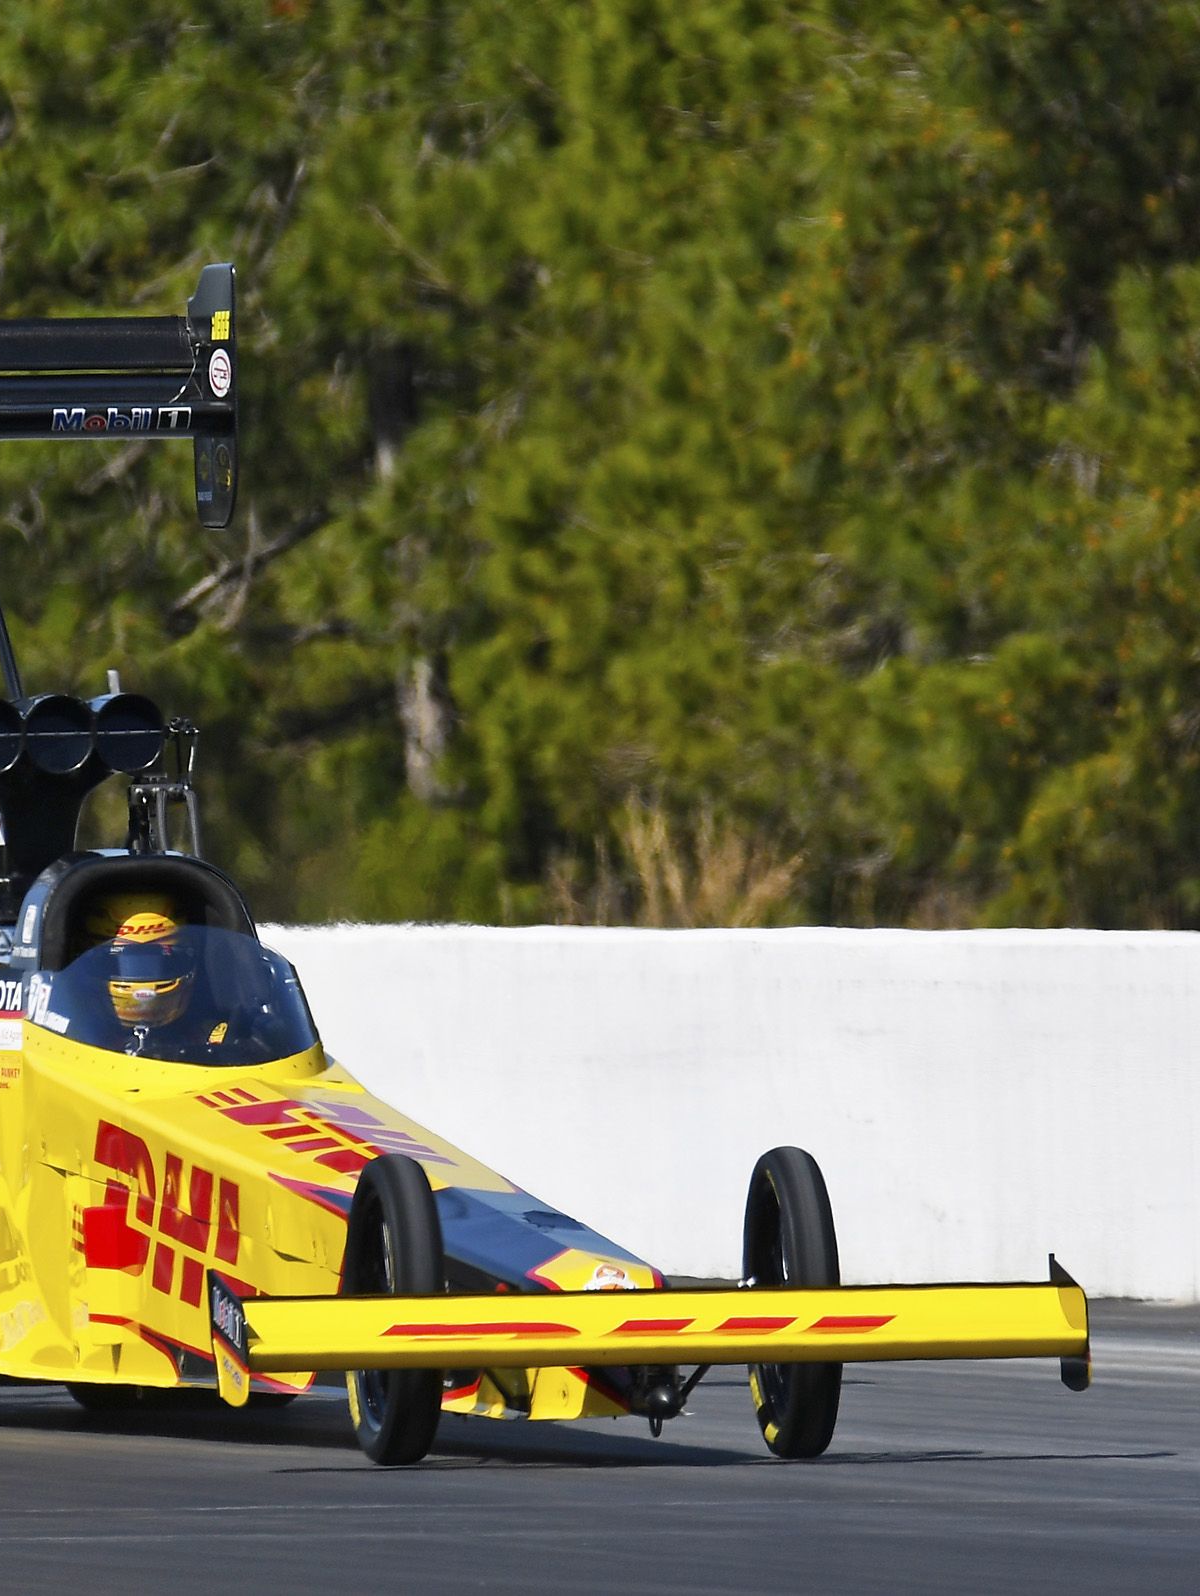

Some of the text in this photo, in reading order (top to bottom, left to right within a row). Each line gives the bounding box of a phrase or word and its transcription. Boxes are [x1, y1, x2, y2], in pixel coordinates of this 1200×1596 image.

[52, 407, 152, 431] Mobil
[116, 923, 167, 936] DHL
[83, 1119, 257, 1309] DHL
